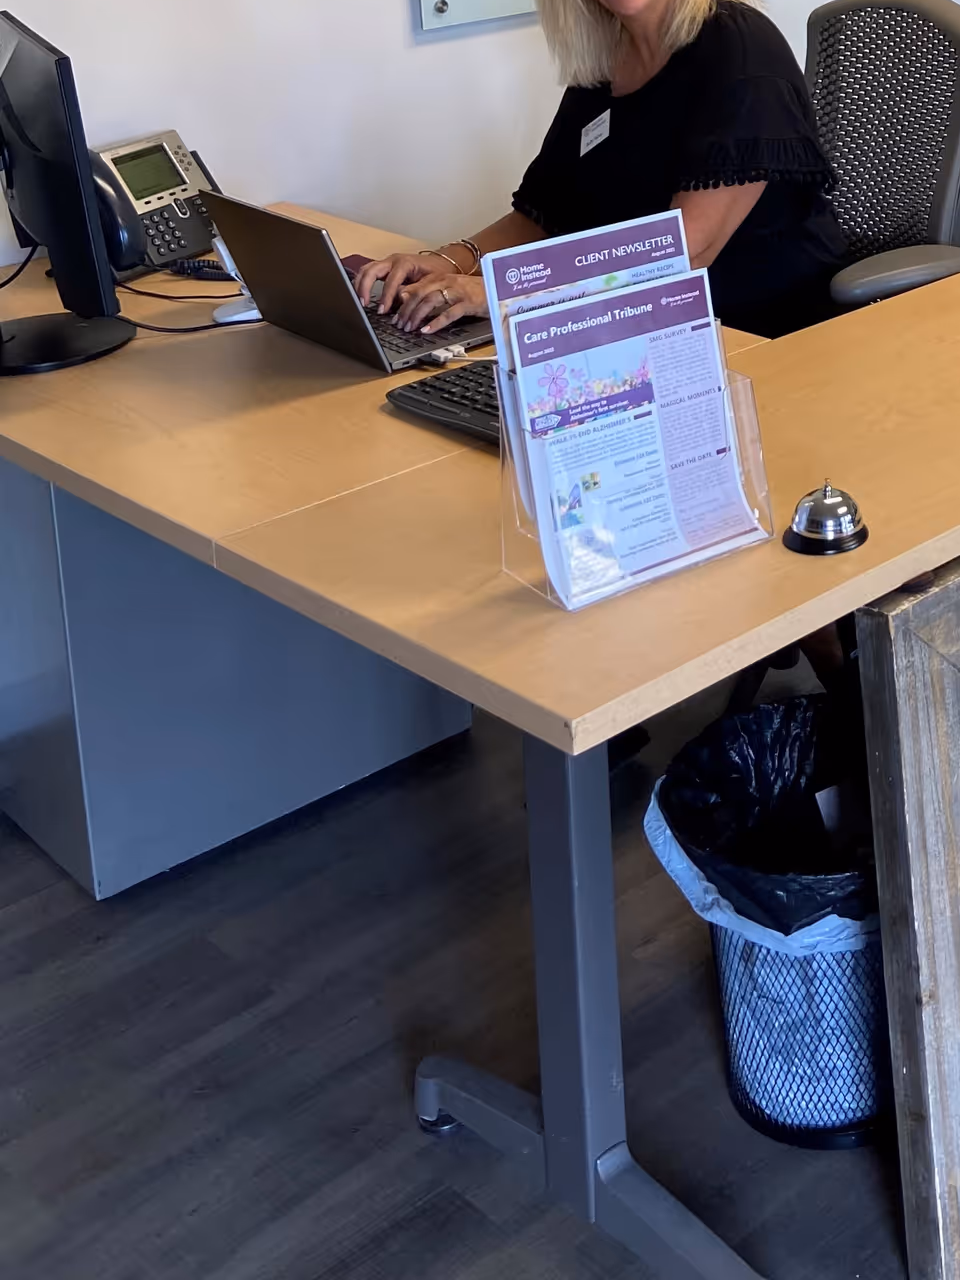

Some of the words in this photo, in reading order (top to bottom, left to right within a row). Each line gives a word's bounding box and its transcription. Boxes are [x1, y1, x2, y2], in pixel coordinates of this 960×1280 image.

[574, 249, 610, 267] CLIENT
[612, 234, 675, 257] NEWSLETTER
[520, 263, 545, 274] Home
[521, 267, 552, 282] Instead
[631, 268, 656, 278] HEALTHY
[656, 263, 675, 273] RECIPE
[681, 290, 700, 299] Instead
[523, 330, 548, 344] Care
[550, 311, 612, 337] Professional
[613, 303, 653, 320] Tribune
[648, 335, 663, 344] SMG
[663, 327, 687, 339] SURVEY
[660, 396, 686, 409] MAGICAL
[687, 387, 717, 400] MOMENTS
[670, 460, 684, 470] SAVE
[686, 457, 697, 465] THE
